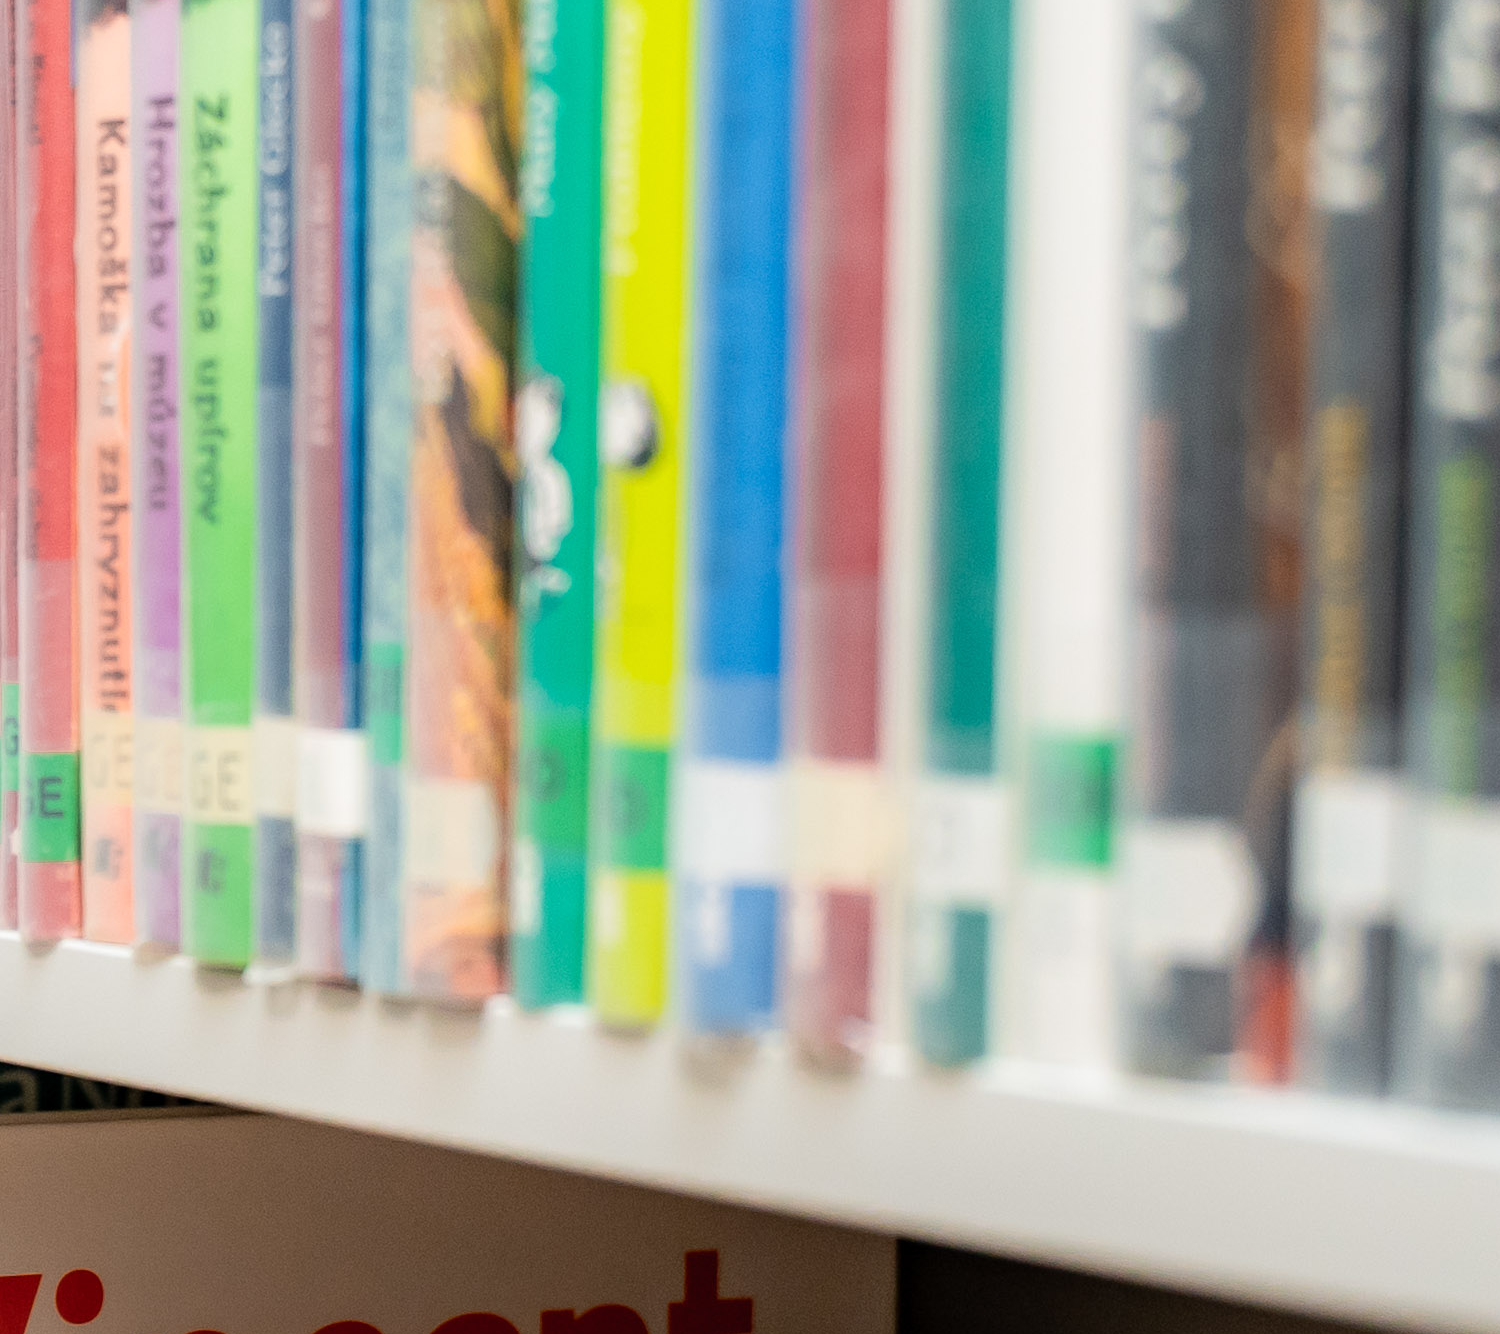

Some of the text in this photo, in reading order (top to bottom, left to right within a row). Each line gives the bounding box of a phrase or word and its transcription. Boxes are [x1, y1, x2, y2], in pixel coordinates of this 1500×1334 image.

[96, 119, 128, 336] Kamoška
[146, 97, 175, 279] Hrozba
[194, 97, 230, 333] Záchrana
[149, 304, 169, 331] v
[91, 444, 130, 712] zahryznuti
